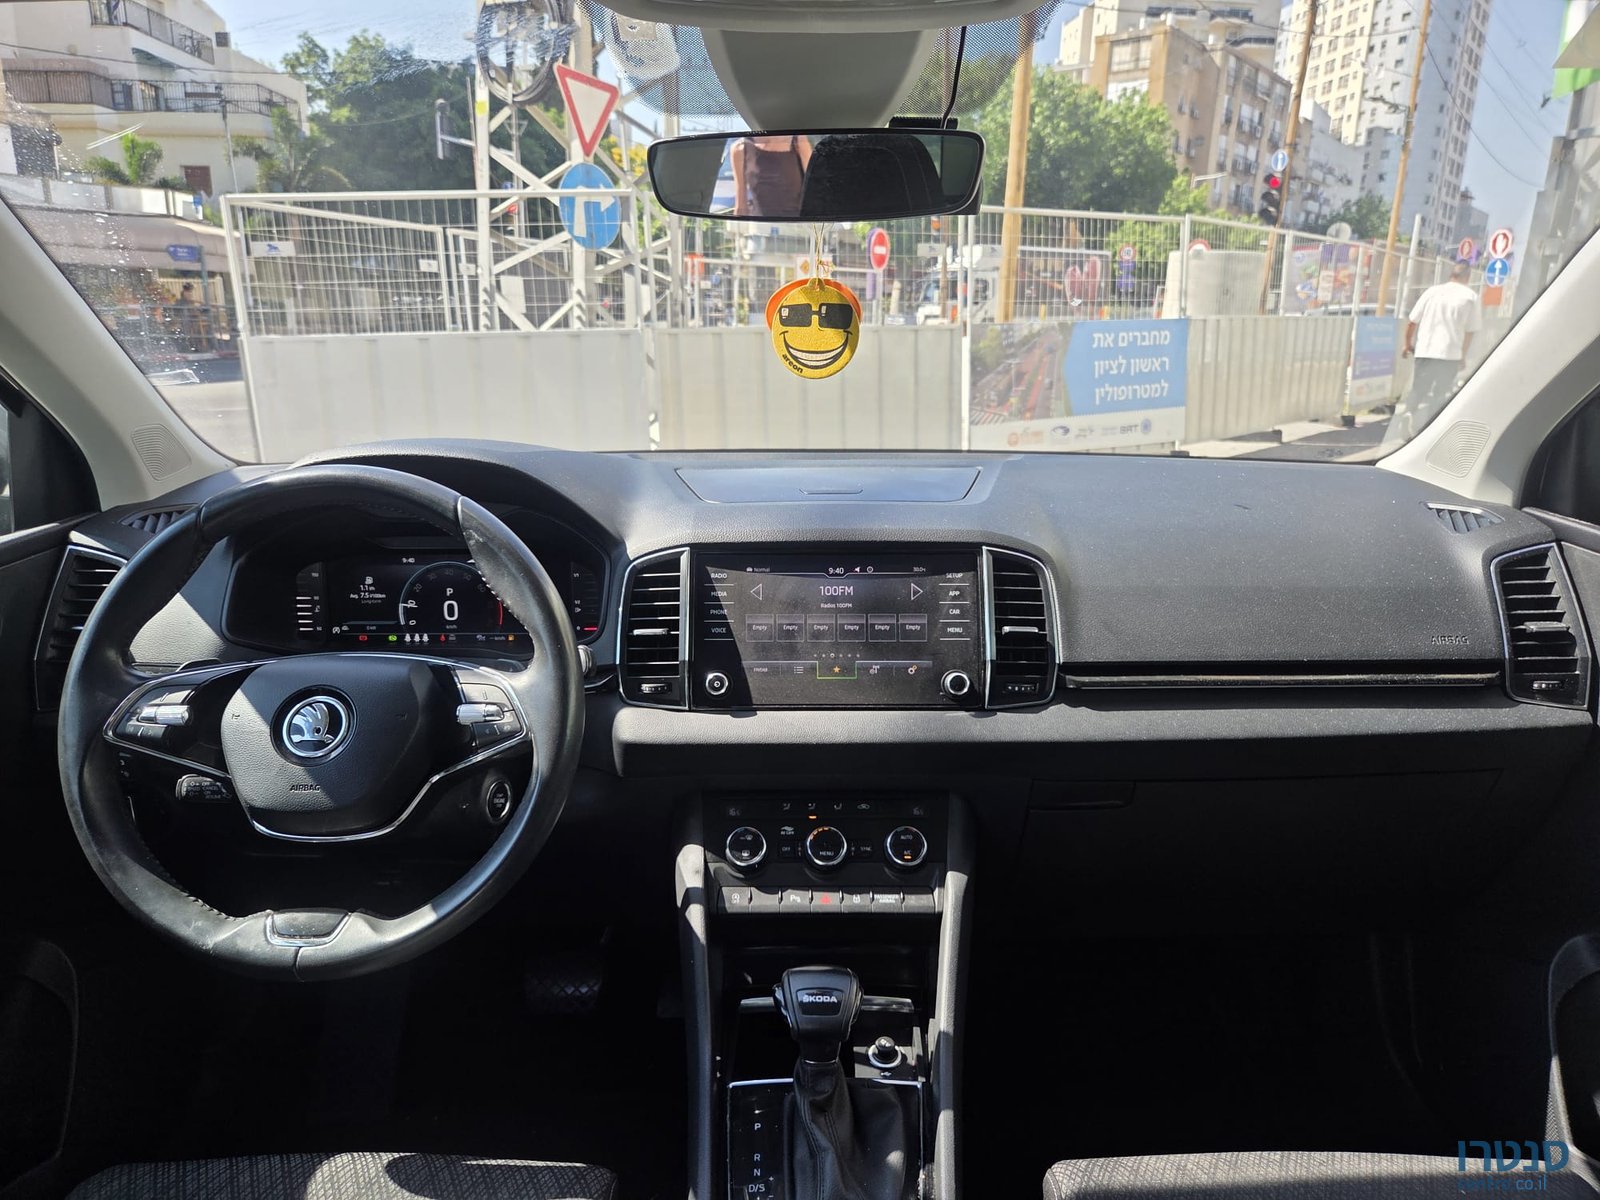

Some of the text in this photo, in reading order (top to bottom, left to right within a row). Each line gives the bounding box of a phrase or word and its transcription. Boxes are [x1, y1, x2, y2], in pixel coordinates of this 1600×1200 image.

[1092, 330, 1170, 349] מחברים את
[782, 353, 804, 373] areon
[1094, 356, 1170, 378] ראשון לציון
[1095, 379, 1169, 405] למטרופולין
[828, 567, 845, 575] 9:40
[446, 588, 454, 596] P
[819, 586, 854, 596] 100FM
[444, 601, 459, 621] 0
[752, 624, 768, 632] Empty
[783, 624, 798, 632] Empty
[813, 624, 829, 632] Empty
[844, 624, 860, 632] Empty
[875, 624, 890, 632] Empty
[905, 624, 921, 632] Empty
[1431, 635, 1470, 646] AIRBAG
[290, 783, 321, 791] AIRBAG
[754, 1122, 762, 1131] P
[753, 1153, 761, 1162] R
[753, 1168, 761, 1177] N
[748, 1183, 766, 1193] D/S
